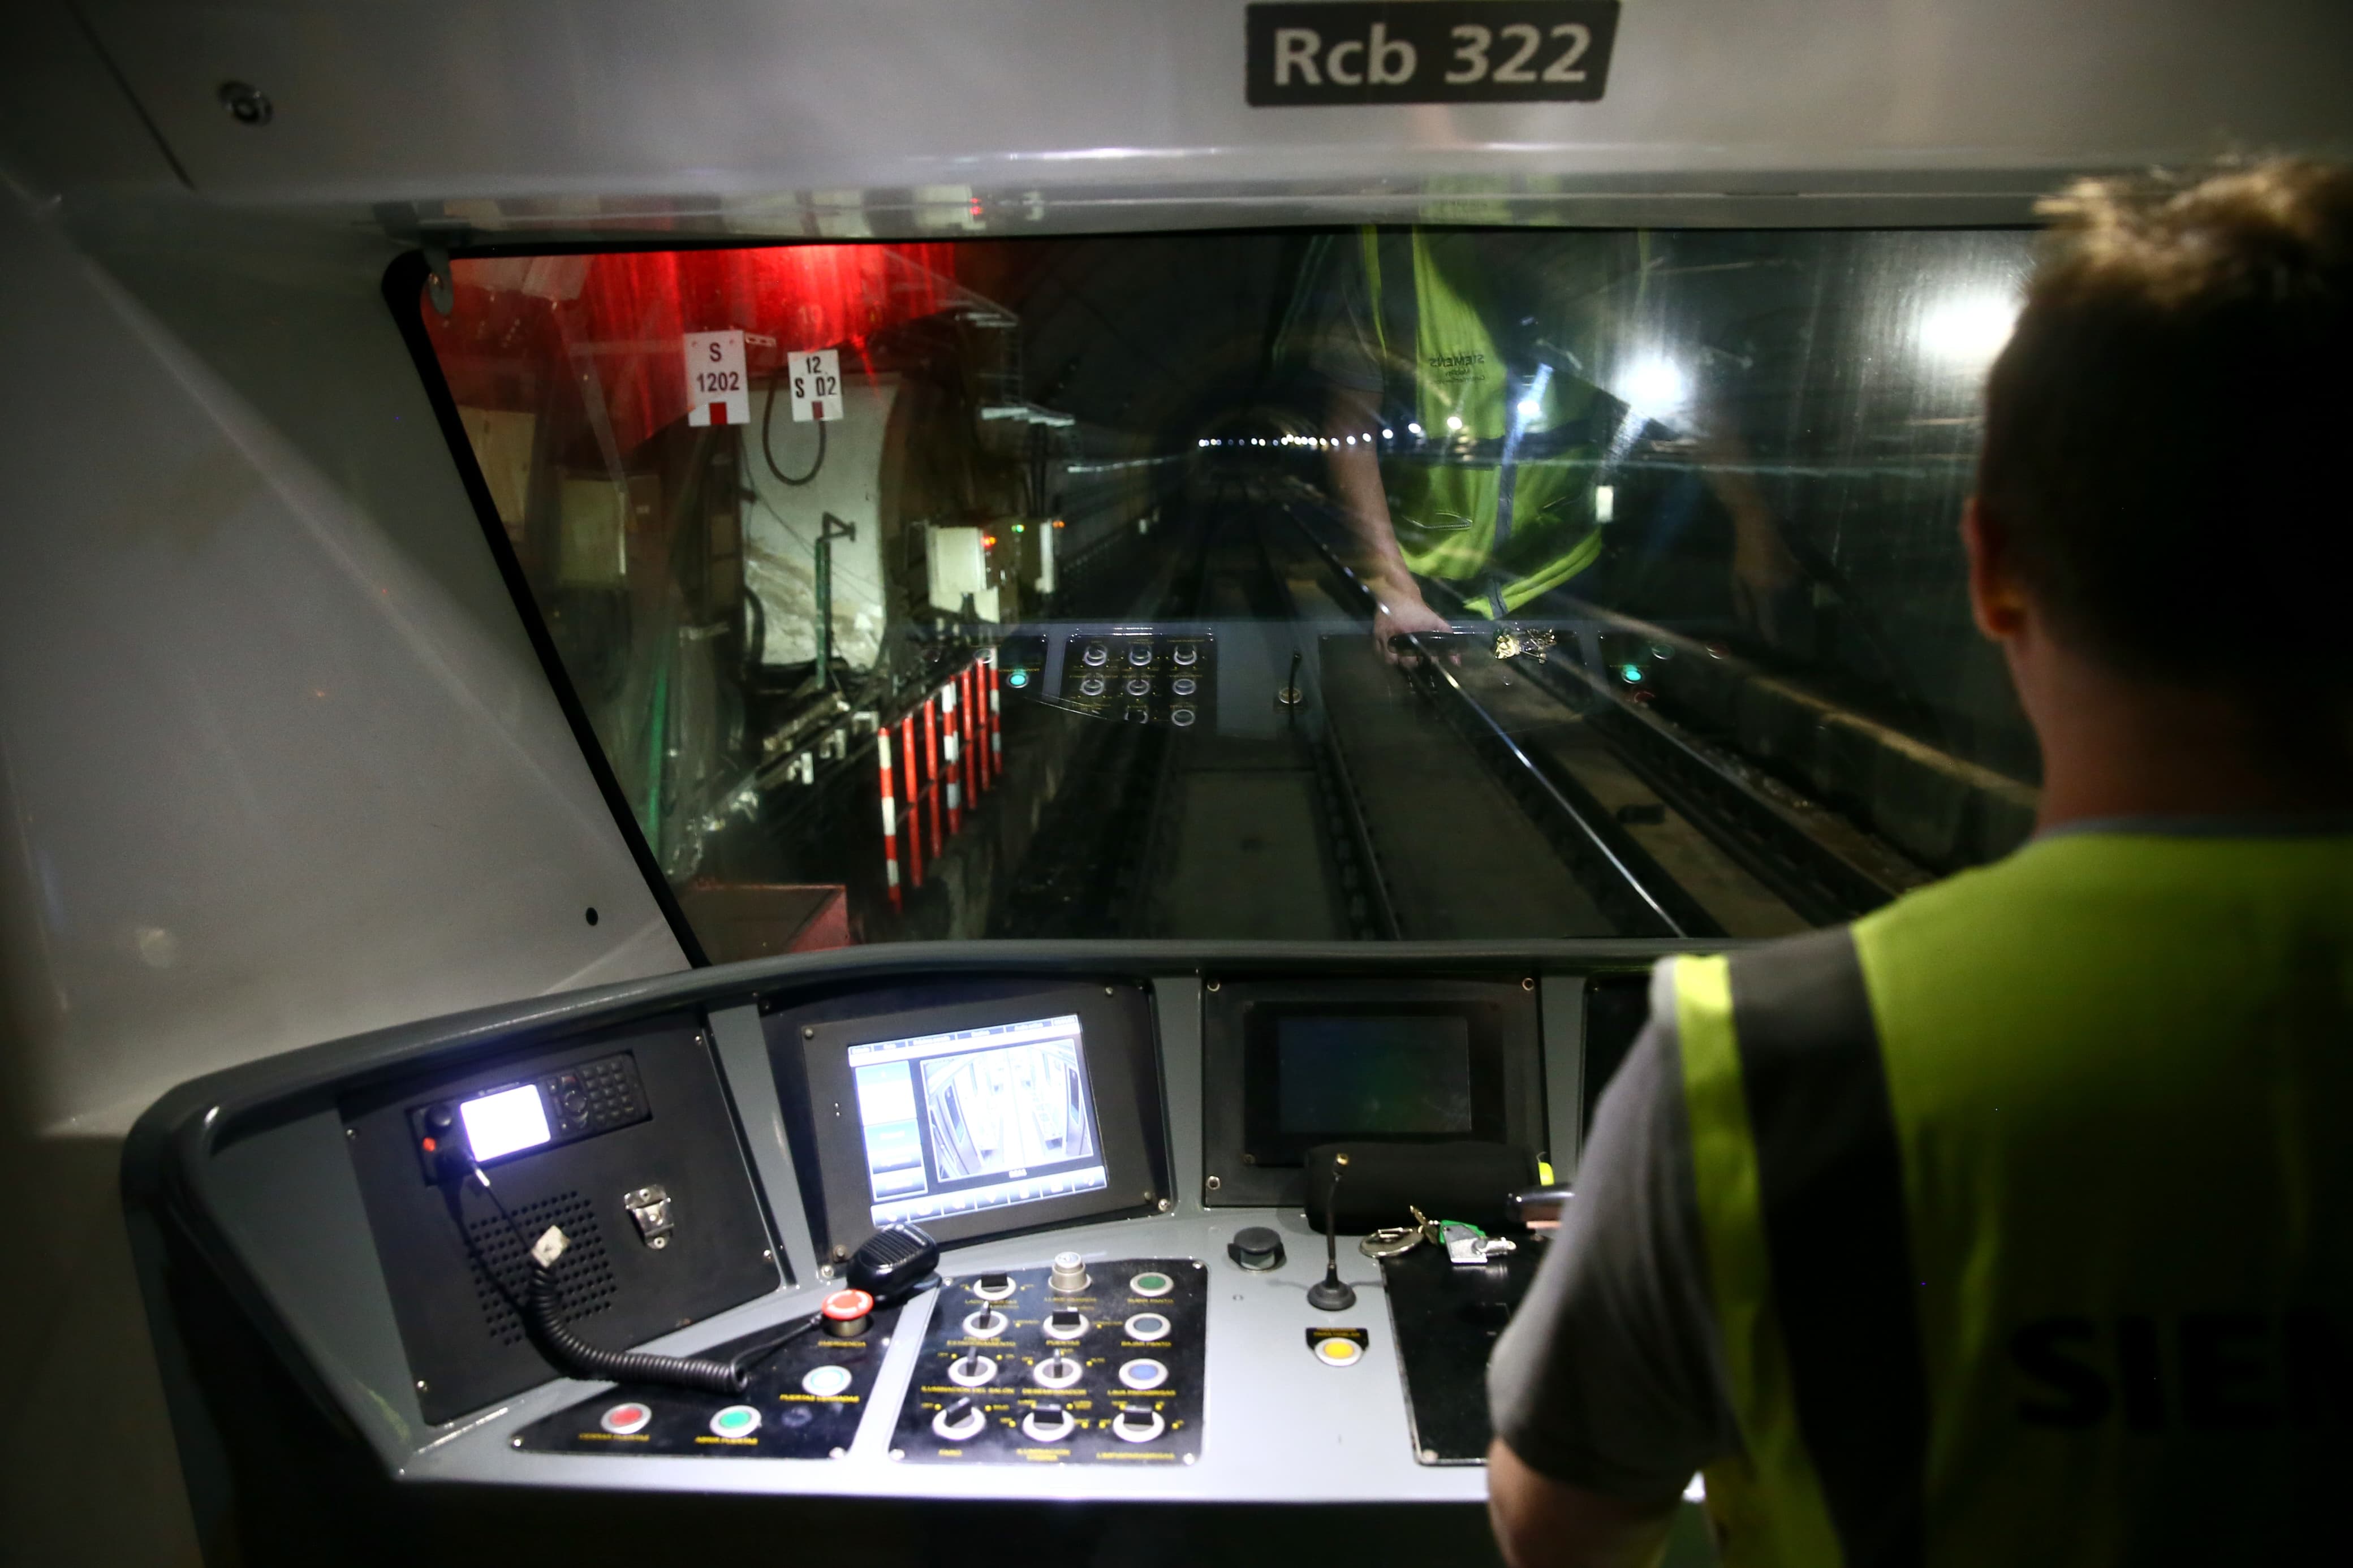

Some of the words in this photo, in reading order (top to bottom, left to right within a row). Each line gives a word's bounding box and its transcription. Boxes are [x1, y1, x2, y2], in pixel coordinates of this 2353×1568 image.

[1274, 23, 1417, 86] Rcb
[1444, 23, 1591, 84] 322
[709, 342, 722, 362] S
[805, 356, 821, 374] 12
[696, 372, 739, 392] 1202
[795, 378, 805, 399] S
